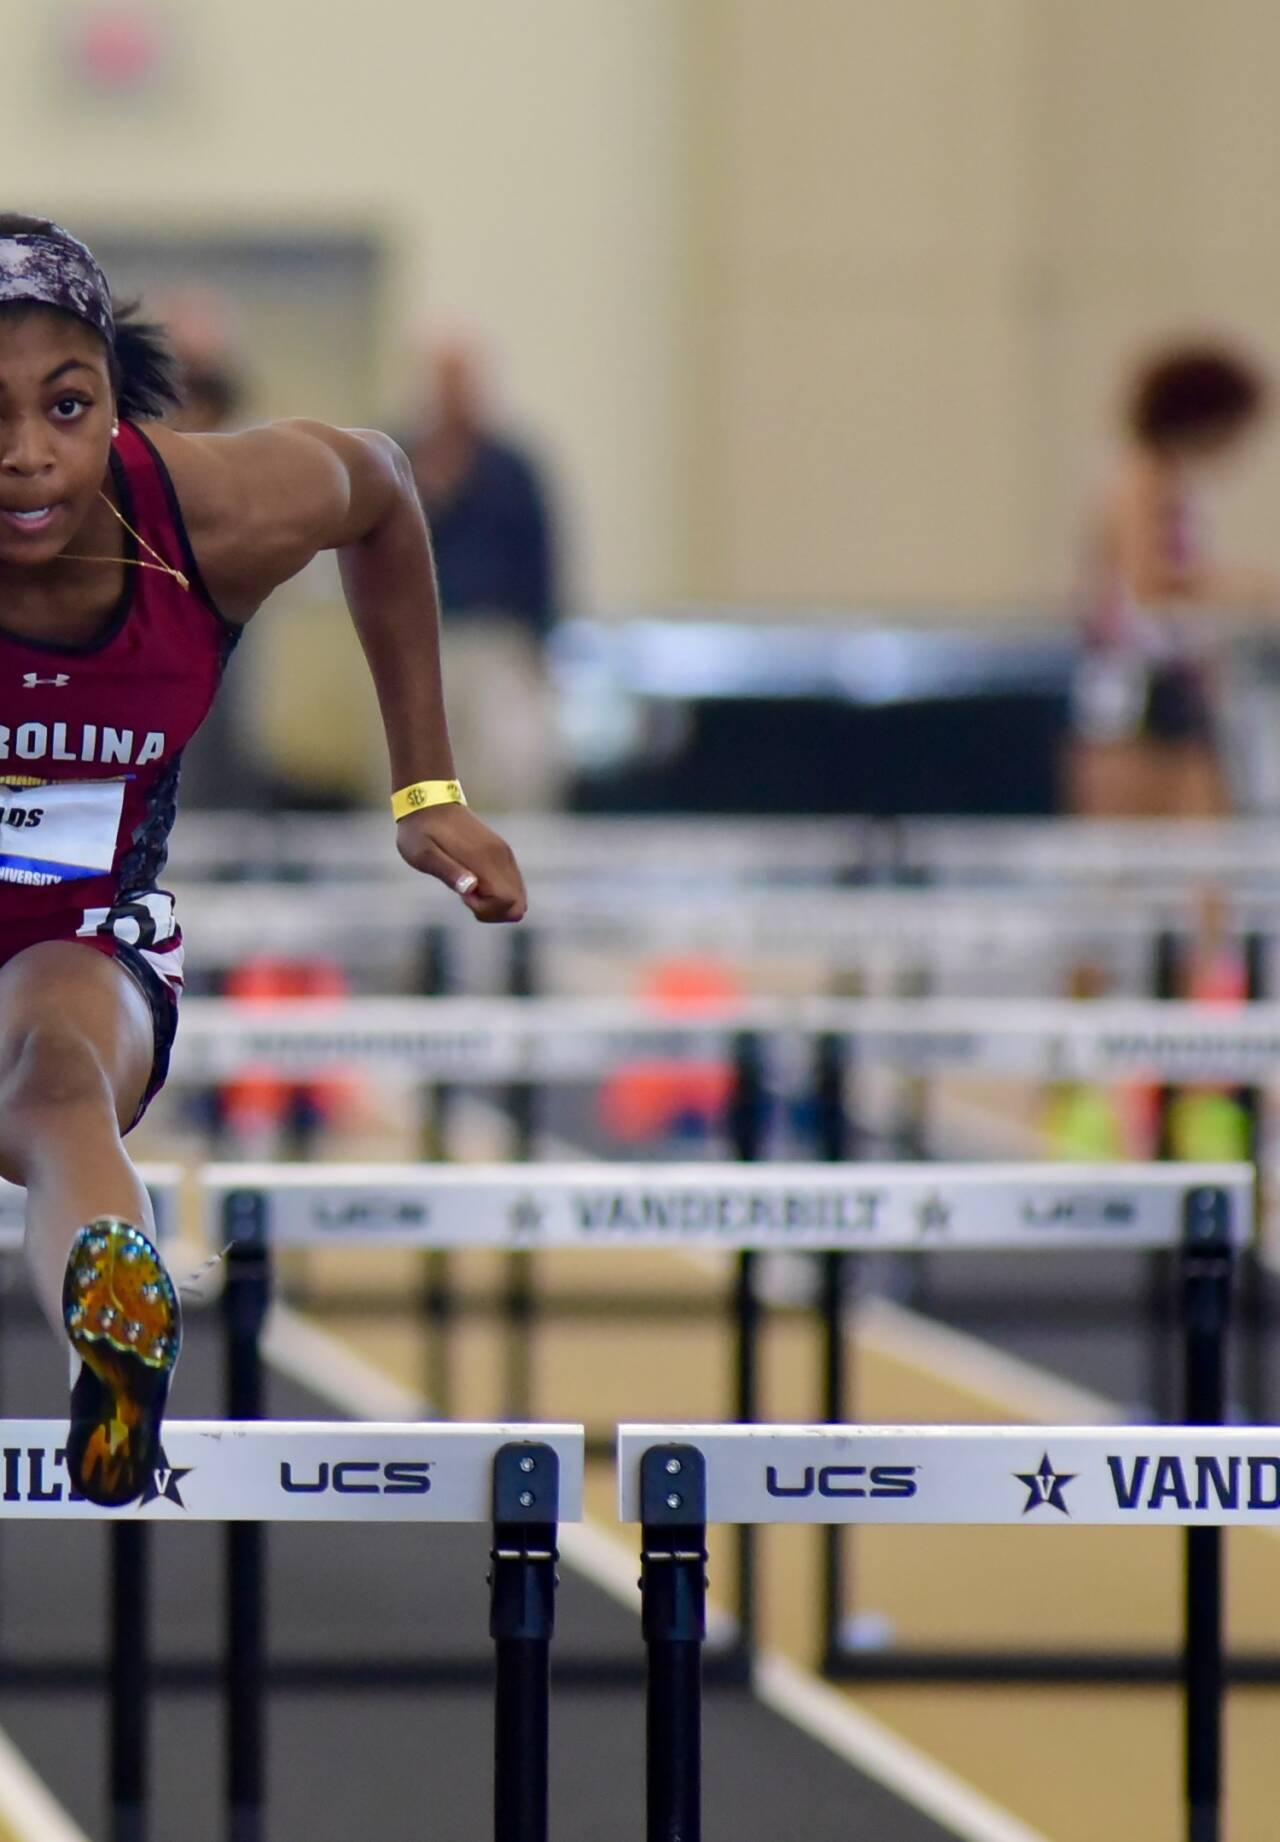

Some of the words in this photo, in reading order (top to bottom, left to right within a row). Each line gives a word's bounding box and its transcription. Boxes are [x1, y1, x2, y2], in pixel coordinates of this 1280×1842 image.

[573, 1190, 885, 1236] VANDERBILT
[280, 1462, 431, 1494] UCS
[766, 1466, 917, 1498] UCS
